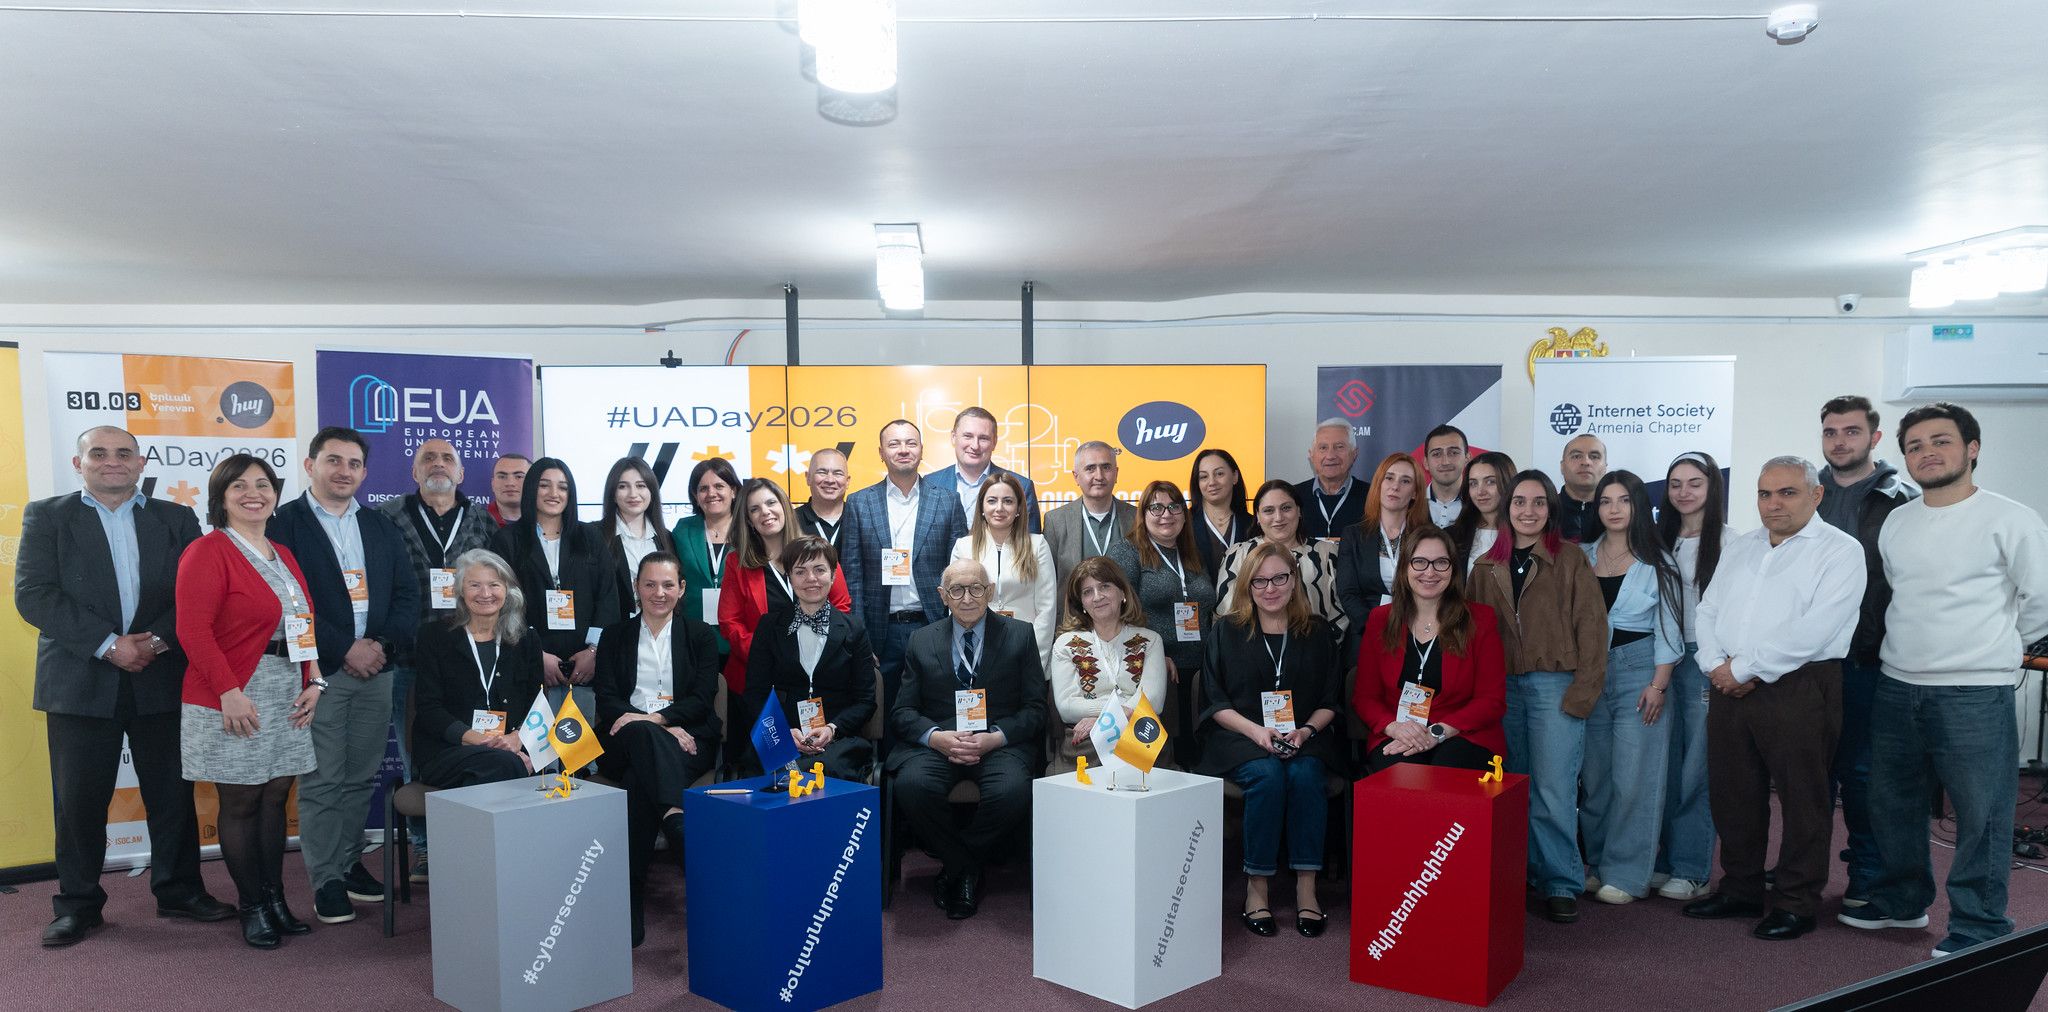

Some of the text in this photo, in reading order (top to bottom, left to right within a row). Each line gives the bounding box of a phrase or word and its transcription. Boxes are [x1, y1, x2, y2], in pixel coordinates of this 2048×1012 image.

[68, 392, 140, 410] 31.03
[151, 403, 194, 412] Yerevan
[404, 388, 499, 425] EUA
[607, 406, 857, 433] #UADay2026
[1588, 404, 1715, 419] Internet Society
[404, 428, 500, 439] EUROPEAN
[1587, 422, 1702, 435] Armenia Chapter
[404, 439, 500, 449] UNRSITY
[1152, 819, 1205, 968] #digitalsecurity
[522, 838, 605, 985] #cybersecurity
